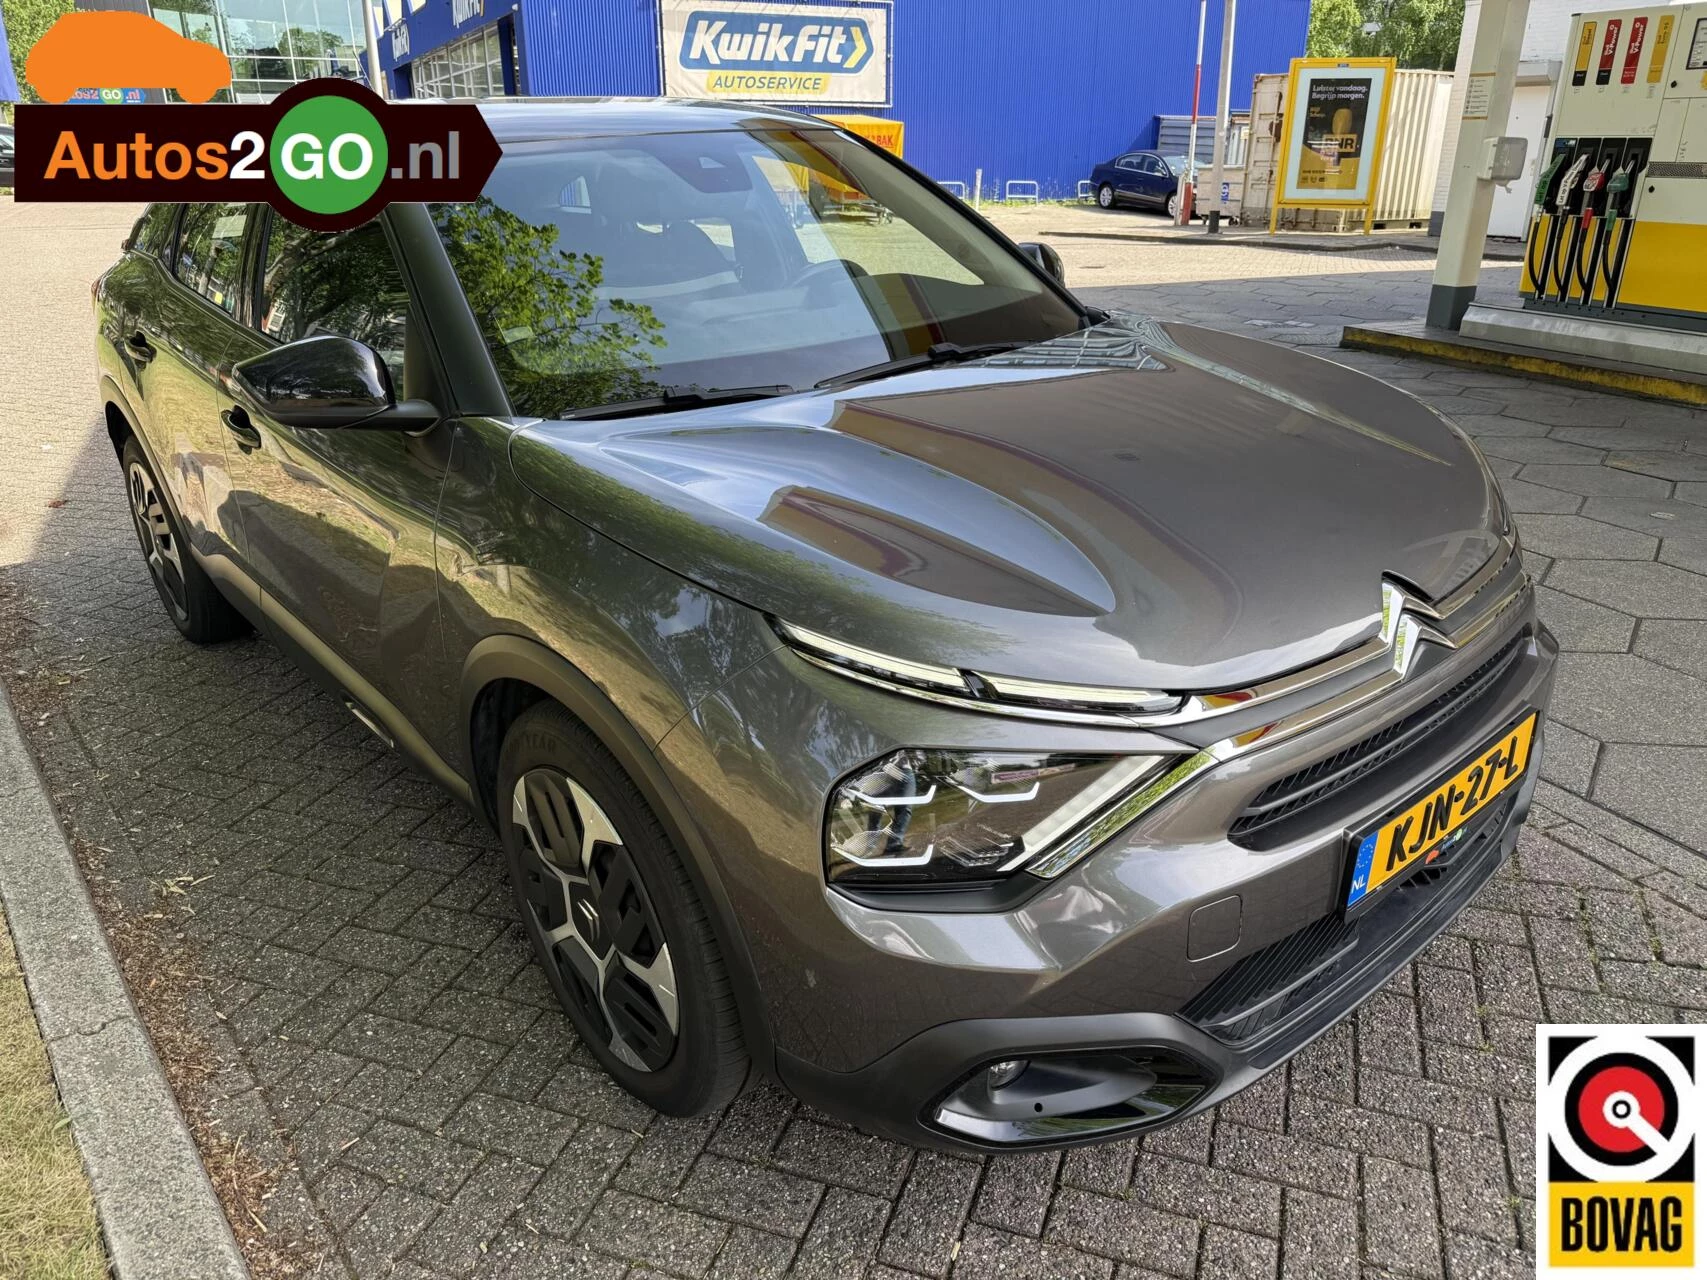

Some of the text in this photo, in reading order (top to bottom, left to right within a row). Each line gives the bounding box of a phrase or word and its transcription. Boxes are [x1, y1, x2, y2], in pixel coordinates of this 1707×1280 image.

[1607, 27, 1618, 55] V-Power
[1632, 24, 1644, 53] V-Power
[713, 75, 822, 90] AUTOSERVICE
[1336, 84, 1368, 92] vandaag.
[1312, 92, 1336, 100] Begrijp
[1385, 735, 1518, 872] KJN-27-L
[1351, 874, 1366, 893] NL
